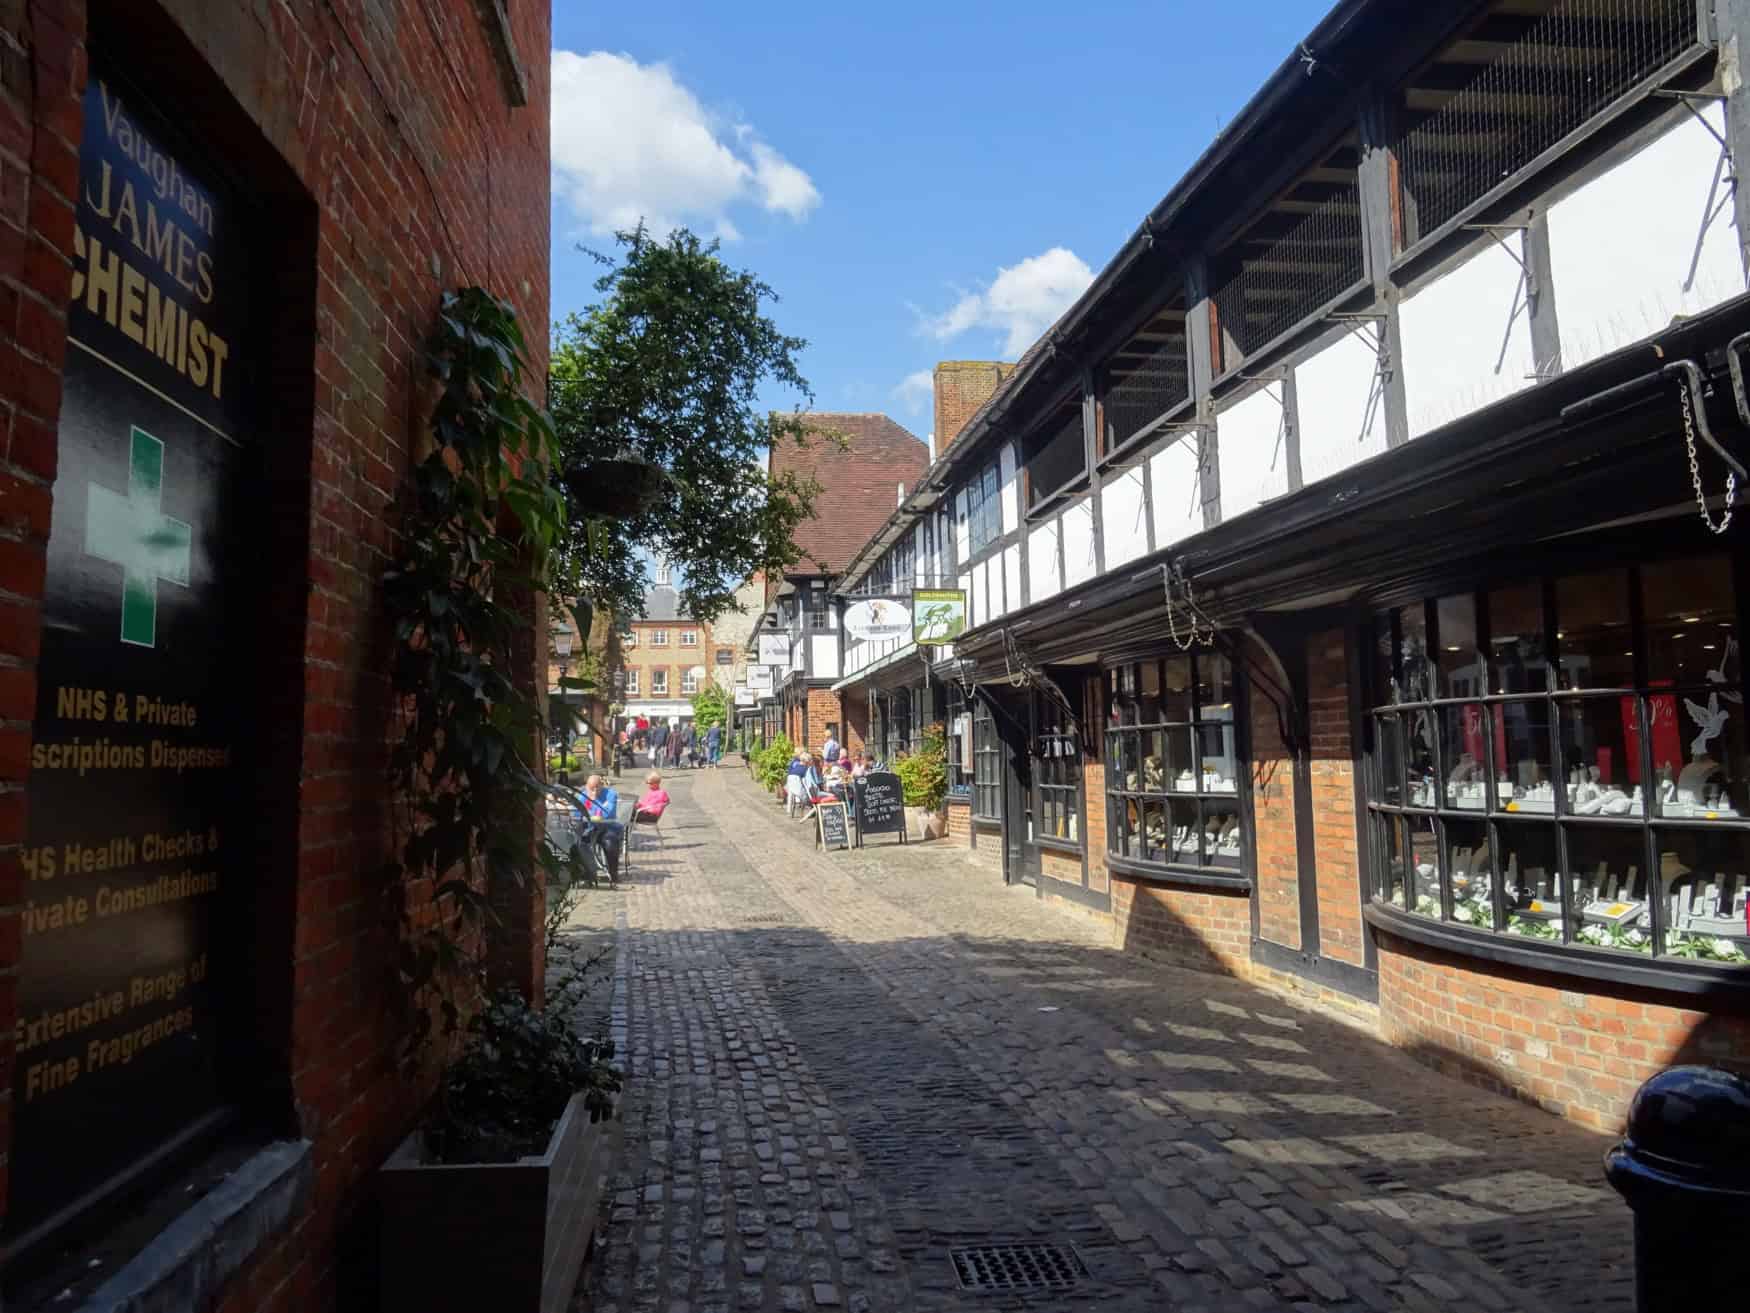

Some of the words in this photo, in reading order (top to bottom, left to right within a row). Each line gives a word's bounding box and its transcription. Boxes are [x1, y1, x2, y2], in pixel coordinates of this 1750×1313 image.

[100, 80, 214, 237] Vaughan
[87, 160, 214, 304] JAMES
[57, 687, 107, 721] NHS
[114, 691, 128, 722] &
[136, 695, 197, 728] Private
[21, 846, 56, 881] HS
[64, 839, 135, 876] Health
[142, 827, 205, 863] Checks
[96, 867, 217, 918] Consultations
[129, 968, 185, 1008] Range
[192, 952, 208, 985] of
[26, 1055, 80, 1104] Fine
[87, 1007, 193, 1073] Fragrances
